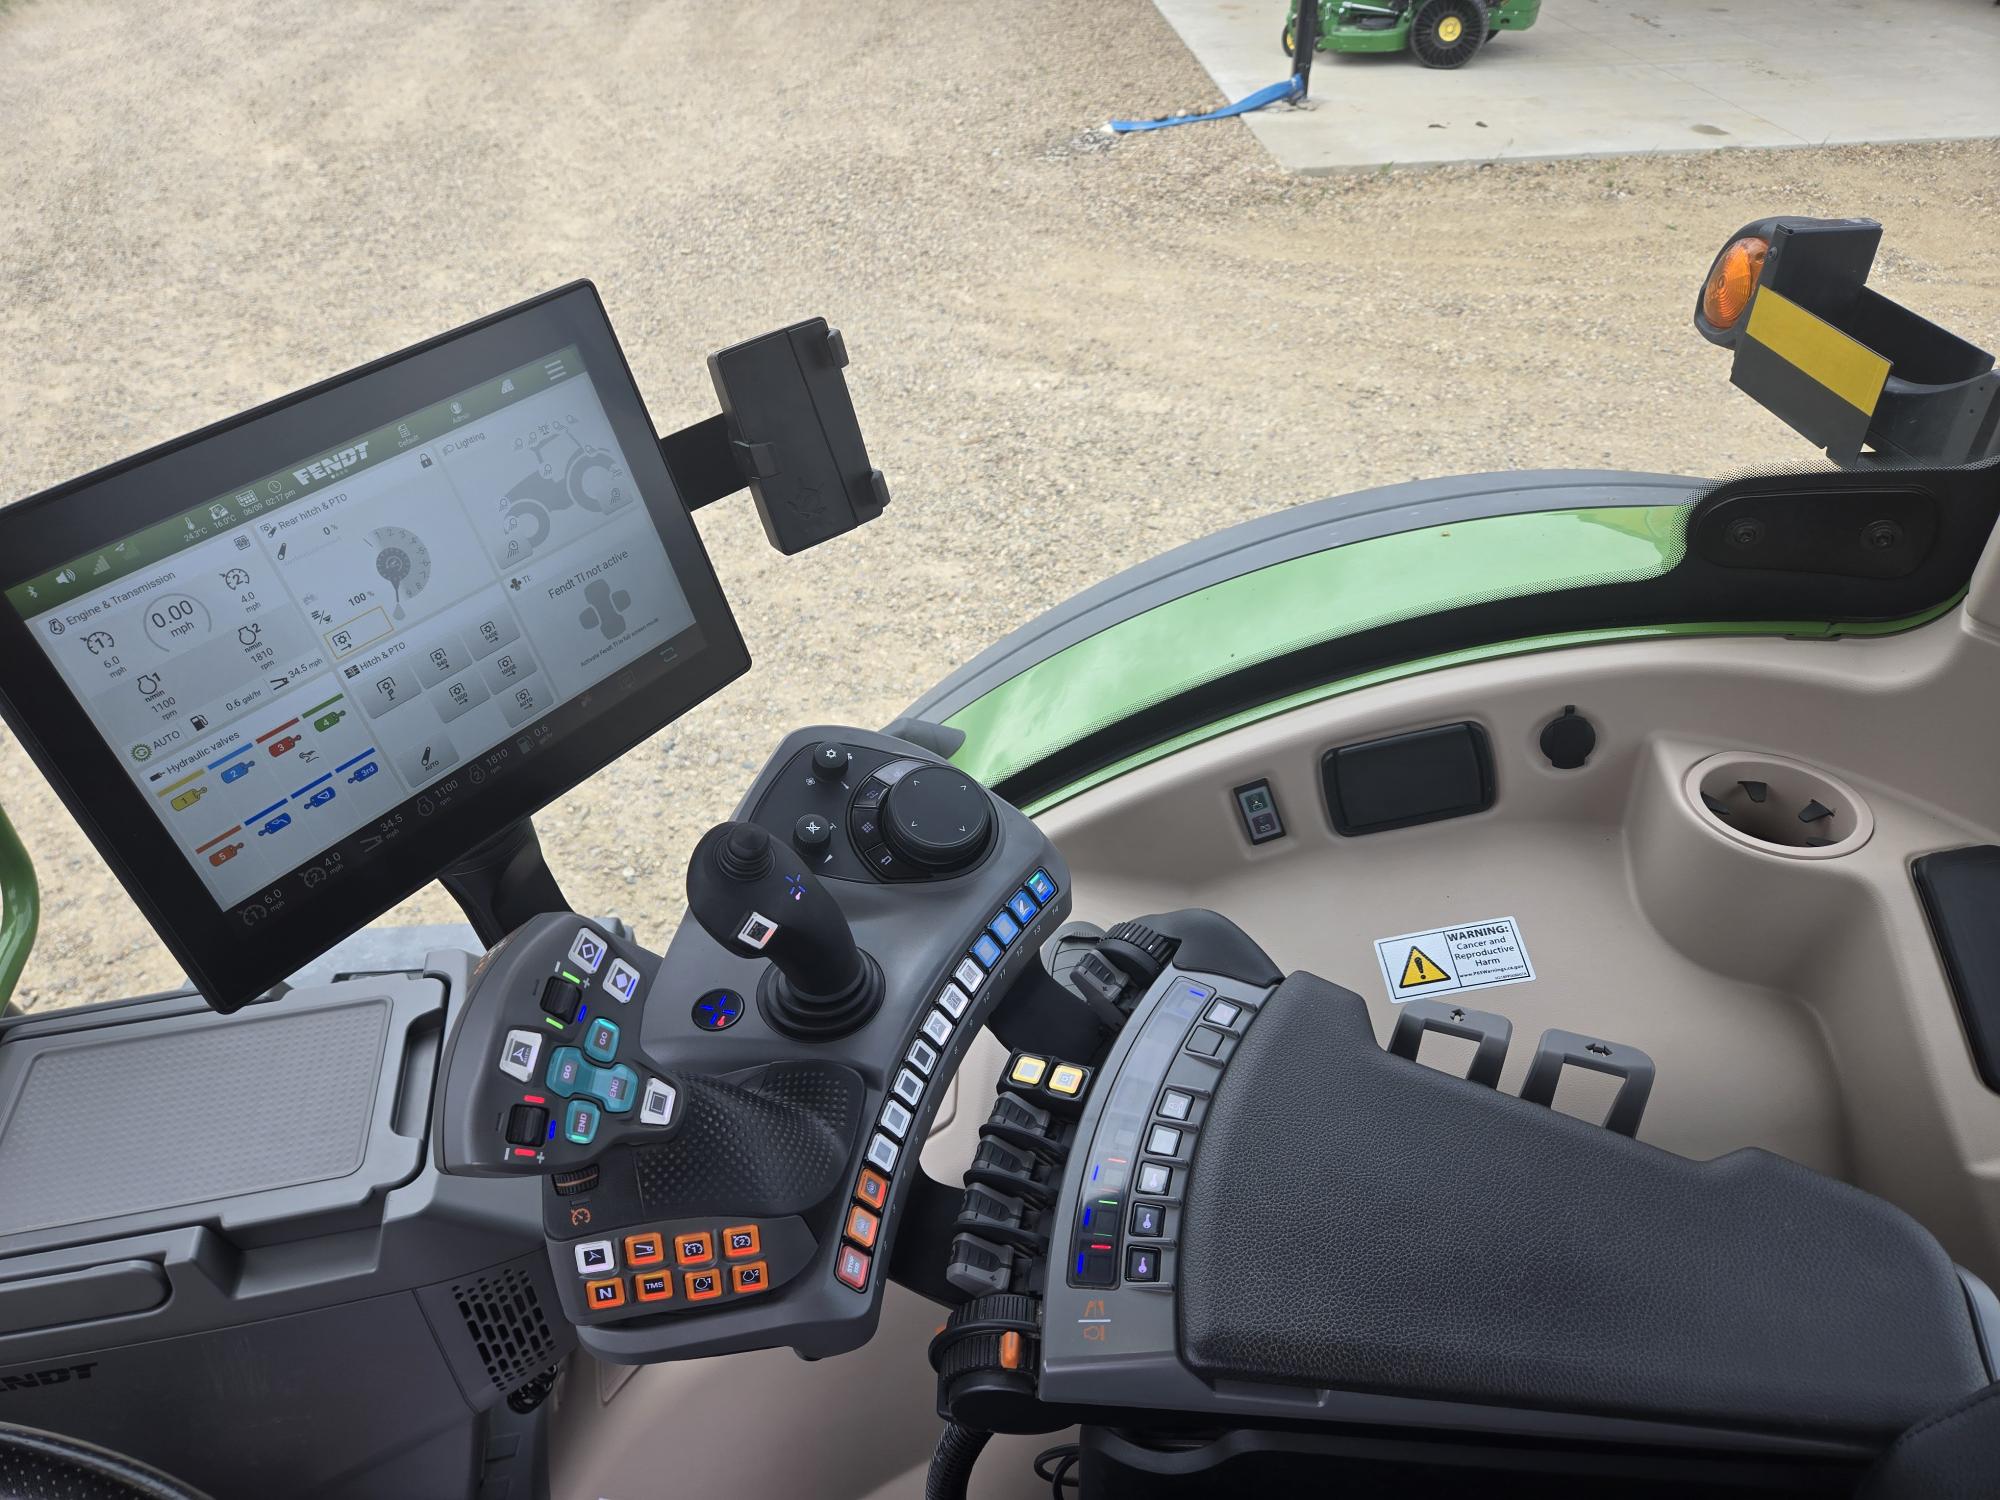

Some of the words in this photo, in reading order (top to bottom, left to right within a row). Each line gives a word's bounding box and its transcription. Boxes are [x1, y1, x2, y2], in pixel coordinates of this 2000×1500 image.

[454, 432, 486, 451] Lighting
[292, 440, 369, 487] FENDT
[265, 494, 283, 506] 02:17
[283, 489, 296, 501] pm
[278, 514, 299, 530] Rear
[299, 506, 322, 521] hitch
[322, 501, 329, 511] &
[328, 493, 348, 507] PTO
[548, 580, 575, 599] Fendt
[574, 572, 587, 584] TI
[585, 565, 601, 579] not
[601, 550, 629, 570] active
[66, 604, 101, 626] Engine
[102, 598, 111, 610] &
[110, 570, 176, 606] Transmission
[240, 591, 255, 604] 4.0
[347, 592, 367, 607] 100
[151, 599, 194, 629] 0.00
[245, 601, 262, 614] mph
[170, 620, 195, 640] mph
[103, 655, 120, 670] 6.0
[250, 647, 274, 665] 1810
[359, 654, 381, 671] Hitch
[381, 650, 389, 661] &
[387, 641, 407, 657] PTO
[109, 666, 128, 680] mph
[260, 660, 275, 671] rpm
[287, 663, 308, 680] 34.5
[308, 656, 323, 669] mph
[151, 696, 176, 715] 1100
[225, 698, 241, 712] 0.6
[241, 688, 262, 706] gal/hr
[161, 709, 178, 723] rpm
[152, 730, 181, 750] AUTO
[277, 743, 285, 752] 3
[166, 745, 211, 775] Hydraulic
[210, 732, 240, 751] valves
[485, 748, 509, 767] 1810
[360, 764, 375, 777] 3rd
[424, 760, 440, 772] AUTO
[433, 779, 459, 798] 1100
[379, 813, 403, 832] 34.5
[324, 852, 342, 868] 4.0
[328, 863, 344, 876] mph
[264, 888, 283, 905] 6.0
[269, 900, 286, 913] mph
[1446, 924, 1510, 942] WARNING:
[1456, 939, 1487, 951] Cancer
[1489, 936, 1507, 946] and
[1454, 945, 1515, 962] Reproductive
[1474, 957, 1501, 968] Harm
[1459, 964, 1525, 979] www.P65Warnings.ca.gov
[599, 1031, 608, 1046] GO
[563, 1063, 572, 1080] GO
[608, 1079, 619, 1098] END
[577, 1112, 587, 1134] END
[645, 1280, 664, 1290] TMS
[599, 1288, 613, 1300] N
[0, 1361, 98, 1392] NDT
